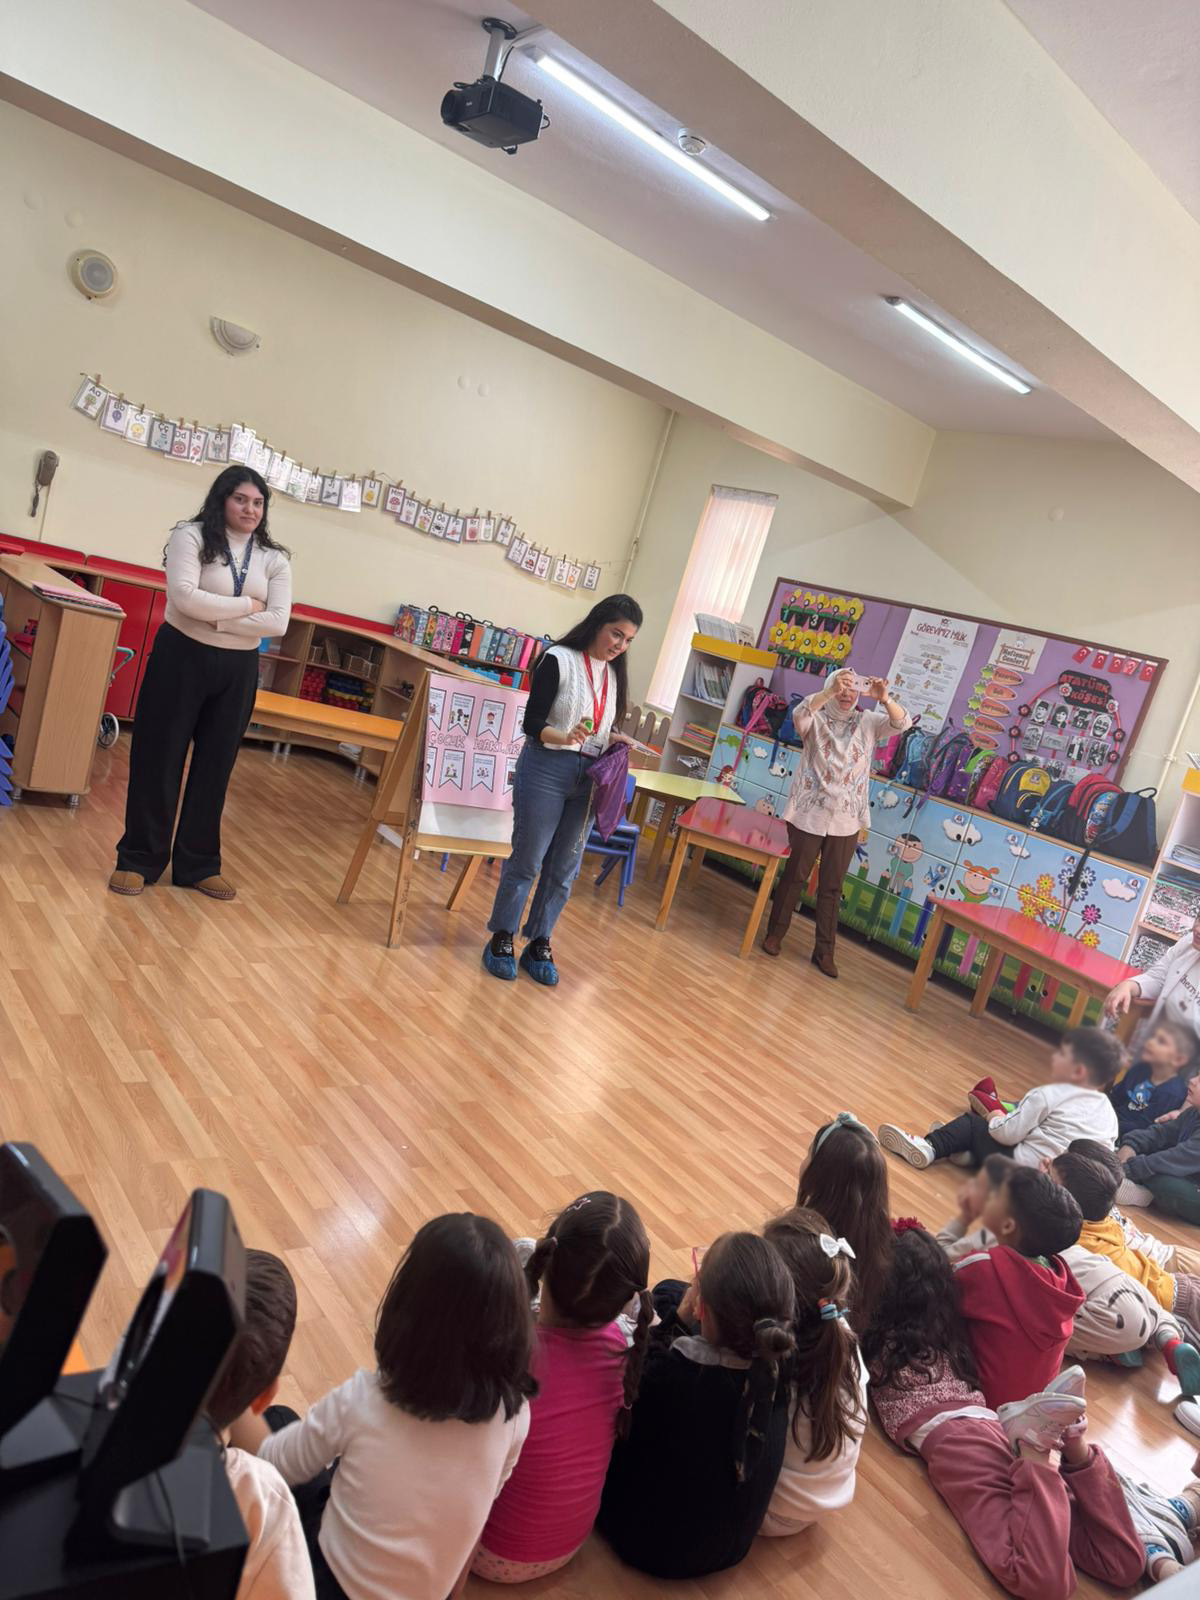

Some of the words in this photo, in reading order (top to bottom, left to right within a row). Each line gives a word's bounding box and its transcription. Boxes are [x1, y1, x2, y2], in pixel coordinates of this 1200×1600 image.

[89, 386, 101, 397] Aa
[113, 401, 126, 412] Bb
[134, 412, 146, 424] Cc
[782, 608, 789, 622] 1
[810, 614, 819, 627] 3
[796, 656, 805, 671] 8
[1060, 674, 1110, 693] ATATÜRK
[430, 730, 466, 748] ÇOCUK
